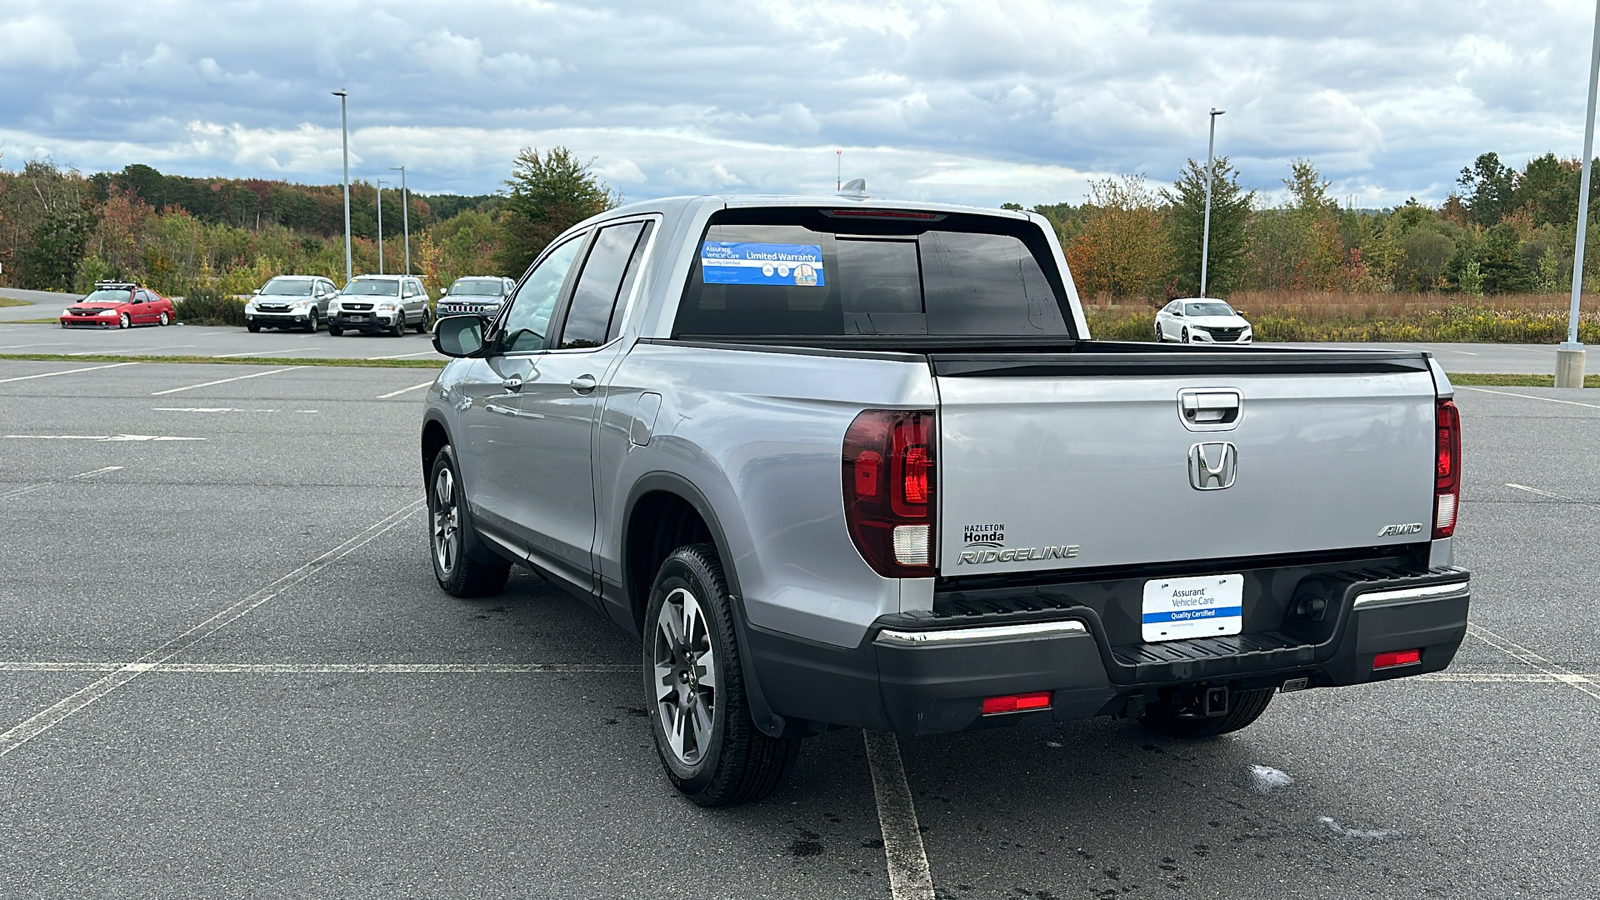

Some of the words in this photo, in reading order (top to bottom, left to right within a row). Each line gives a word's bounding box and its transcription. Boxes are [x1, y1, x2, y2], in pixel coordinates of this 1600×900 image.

[746, 251, 777, 261] Limited
[778, 253, 816, 263] Warranty
[964, 523, 1005, 532] HAZLETON
[1377, 522, 1423, 538] AWD
[964, 532, 1005, 542] Honda
[957, 544, 1080, 565] RIDGELINE
[1172, 588, 1206, 597] Assurant
[1172, 597, 1198, 607] Vehicle
[1198, 596, 1215, 606] Care
[1171, 611, 1191, 620] Quality
[1192, 609, 1215, 618] Certified
